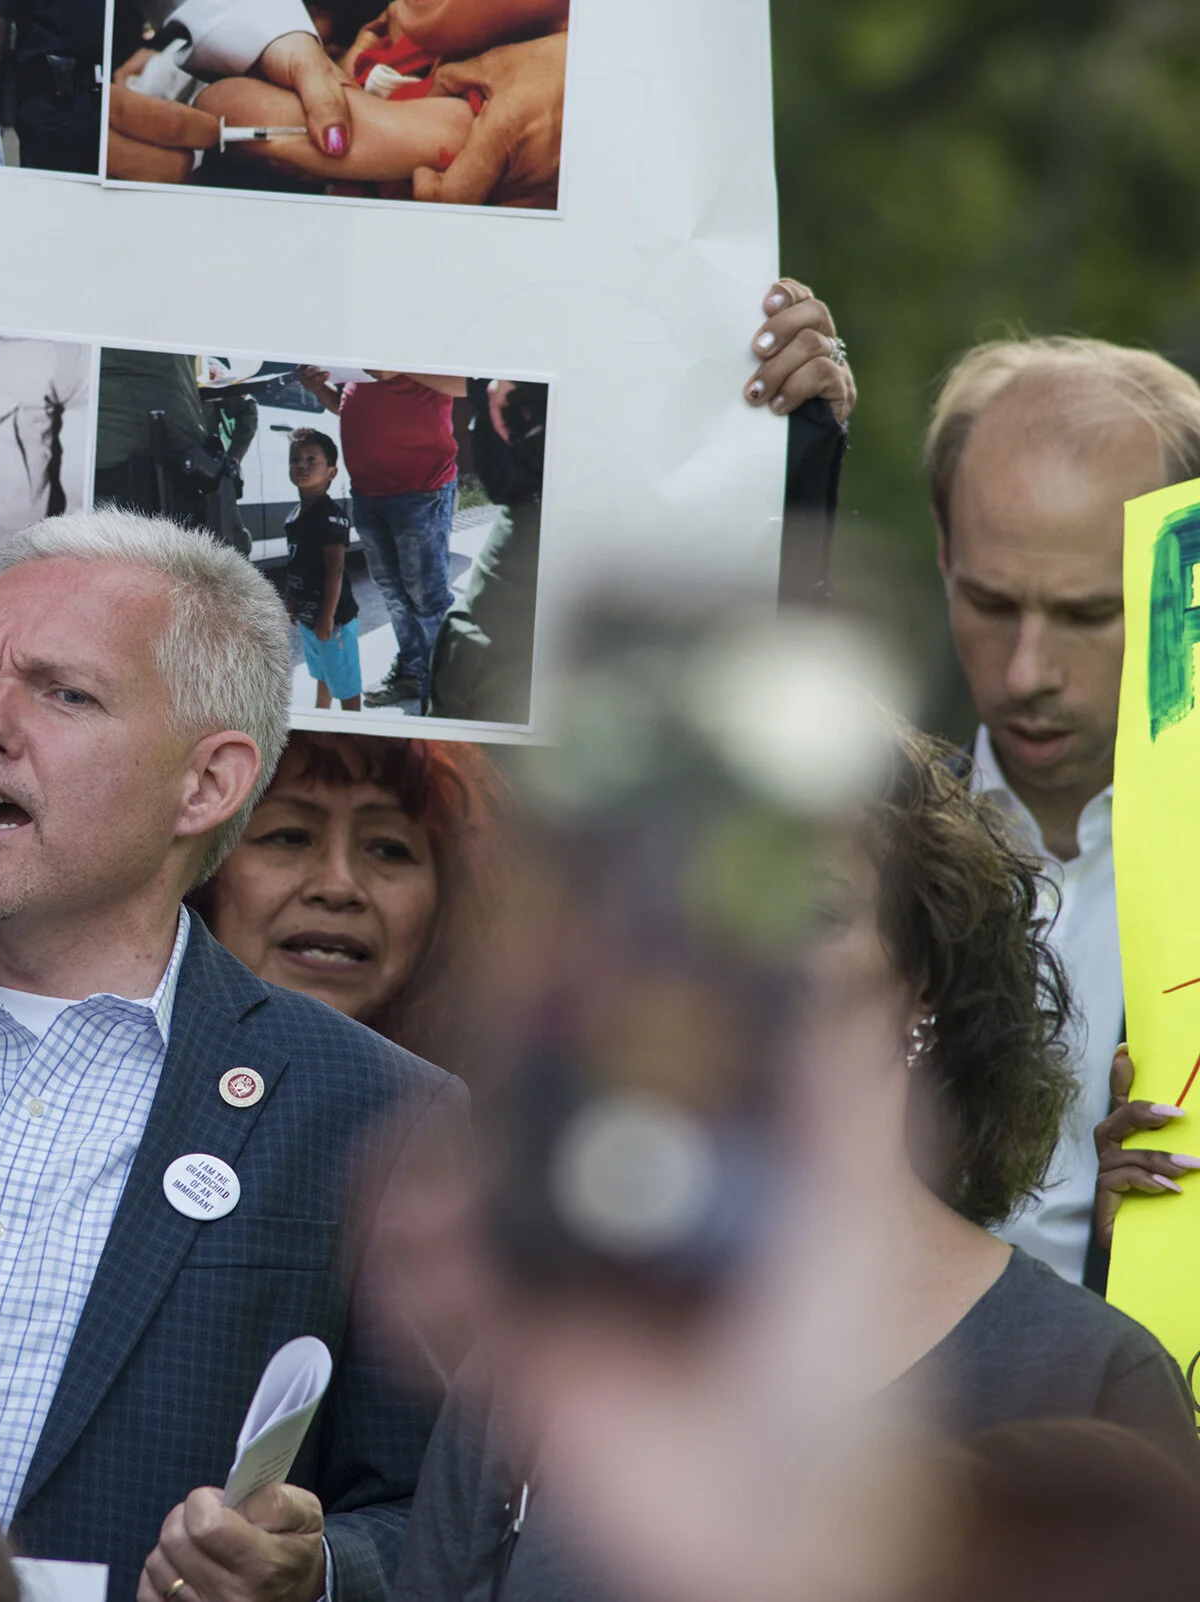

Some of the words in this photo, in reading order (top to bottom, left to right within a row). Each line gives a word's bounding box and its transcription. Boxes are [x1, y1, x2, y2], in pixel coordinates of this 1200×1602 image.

[185, 1164, 230, 1199] GRANDCHILD
[189, 1179, 202, 1189] OF
[198, 1187, 213, 1199] AN
[201, 1164, 217, 1176] AM
[214, 1172, 231, 1187] THE
[172, 1179, 215, 1213] IMMIGRANT
